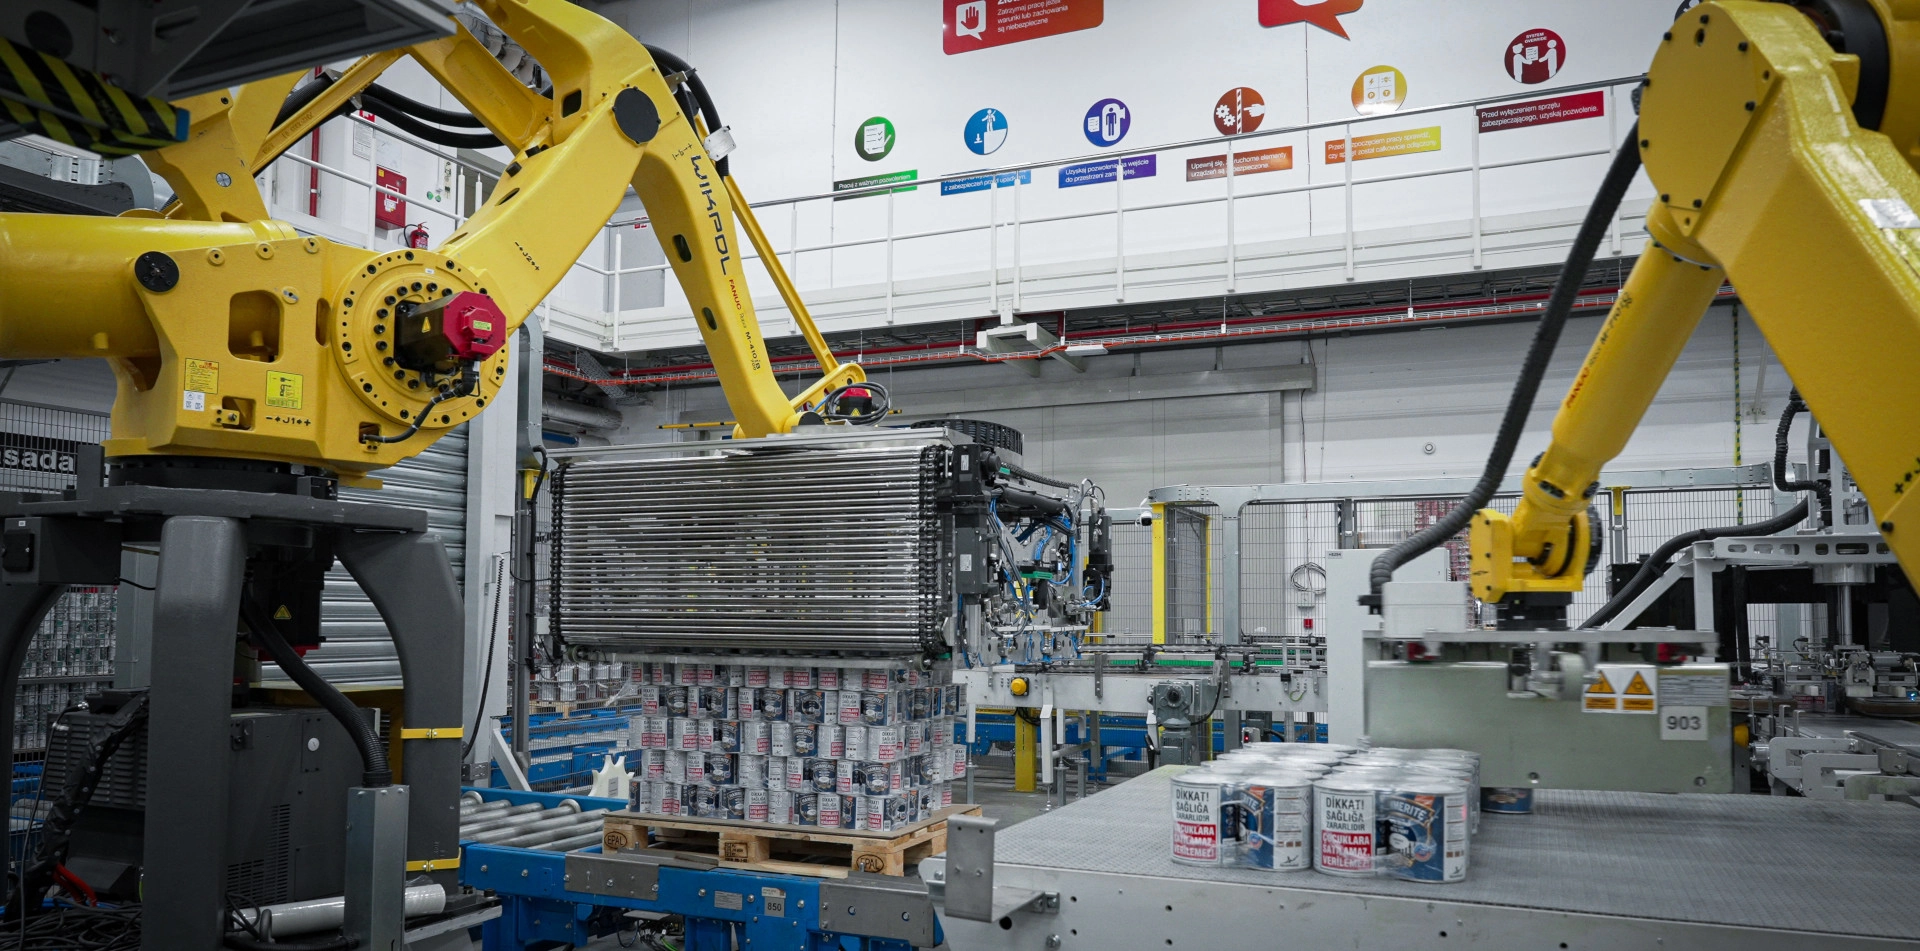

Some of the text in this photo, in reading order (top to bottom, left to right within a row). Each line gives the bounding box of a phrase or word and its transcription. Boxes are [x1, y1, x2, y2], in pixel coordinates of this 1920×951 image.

[997, 6, 1027, 16] Zatrzymaj
[998, 5, 1069, 24] warunki lub zachowania
[1005, 18, 1048, 31] niebezpieczne
[1481, 110, 1499, 118] Przed
[1499, 105, 1537, 116] wyłączeniem
[1539, 110, 1562, 120] uzyskaj
[1328, 143, 1345, 151] Przed
[1233, 156, 1260, 164] ruchome
[1260, 152, 1287, 161] elementy
[1065, 166, 1087, 176] Uzyskaj
[1087, 162, 1118, 174] pozwolenie
[1128, 158, 1150, 168] wejście
[1191, 161, 1214, 170] Upewnij
[1073, 172, 1104, 183] przestrzeni
[690, 155, 731, 276] WIKPOL
[728, 278, 742, 311] FANUC
[0, 449, 75, 472] sada
[1666, 715, 1702, 731] 903
[1176, 788, 1209, 802] DİKKAT!
[1176, 801, 1209, 814] SAĞLIĞA
[1325, 795, 1365, 811] DİKKAT!
[1325, 810, 1365, 823] SAĞLIĞA
[1325, 821, 1366, 832] ZARARLIDIR
[607, 835, 624, 846] EPAL
[767, 902, 782, 911] 850
